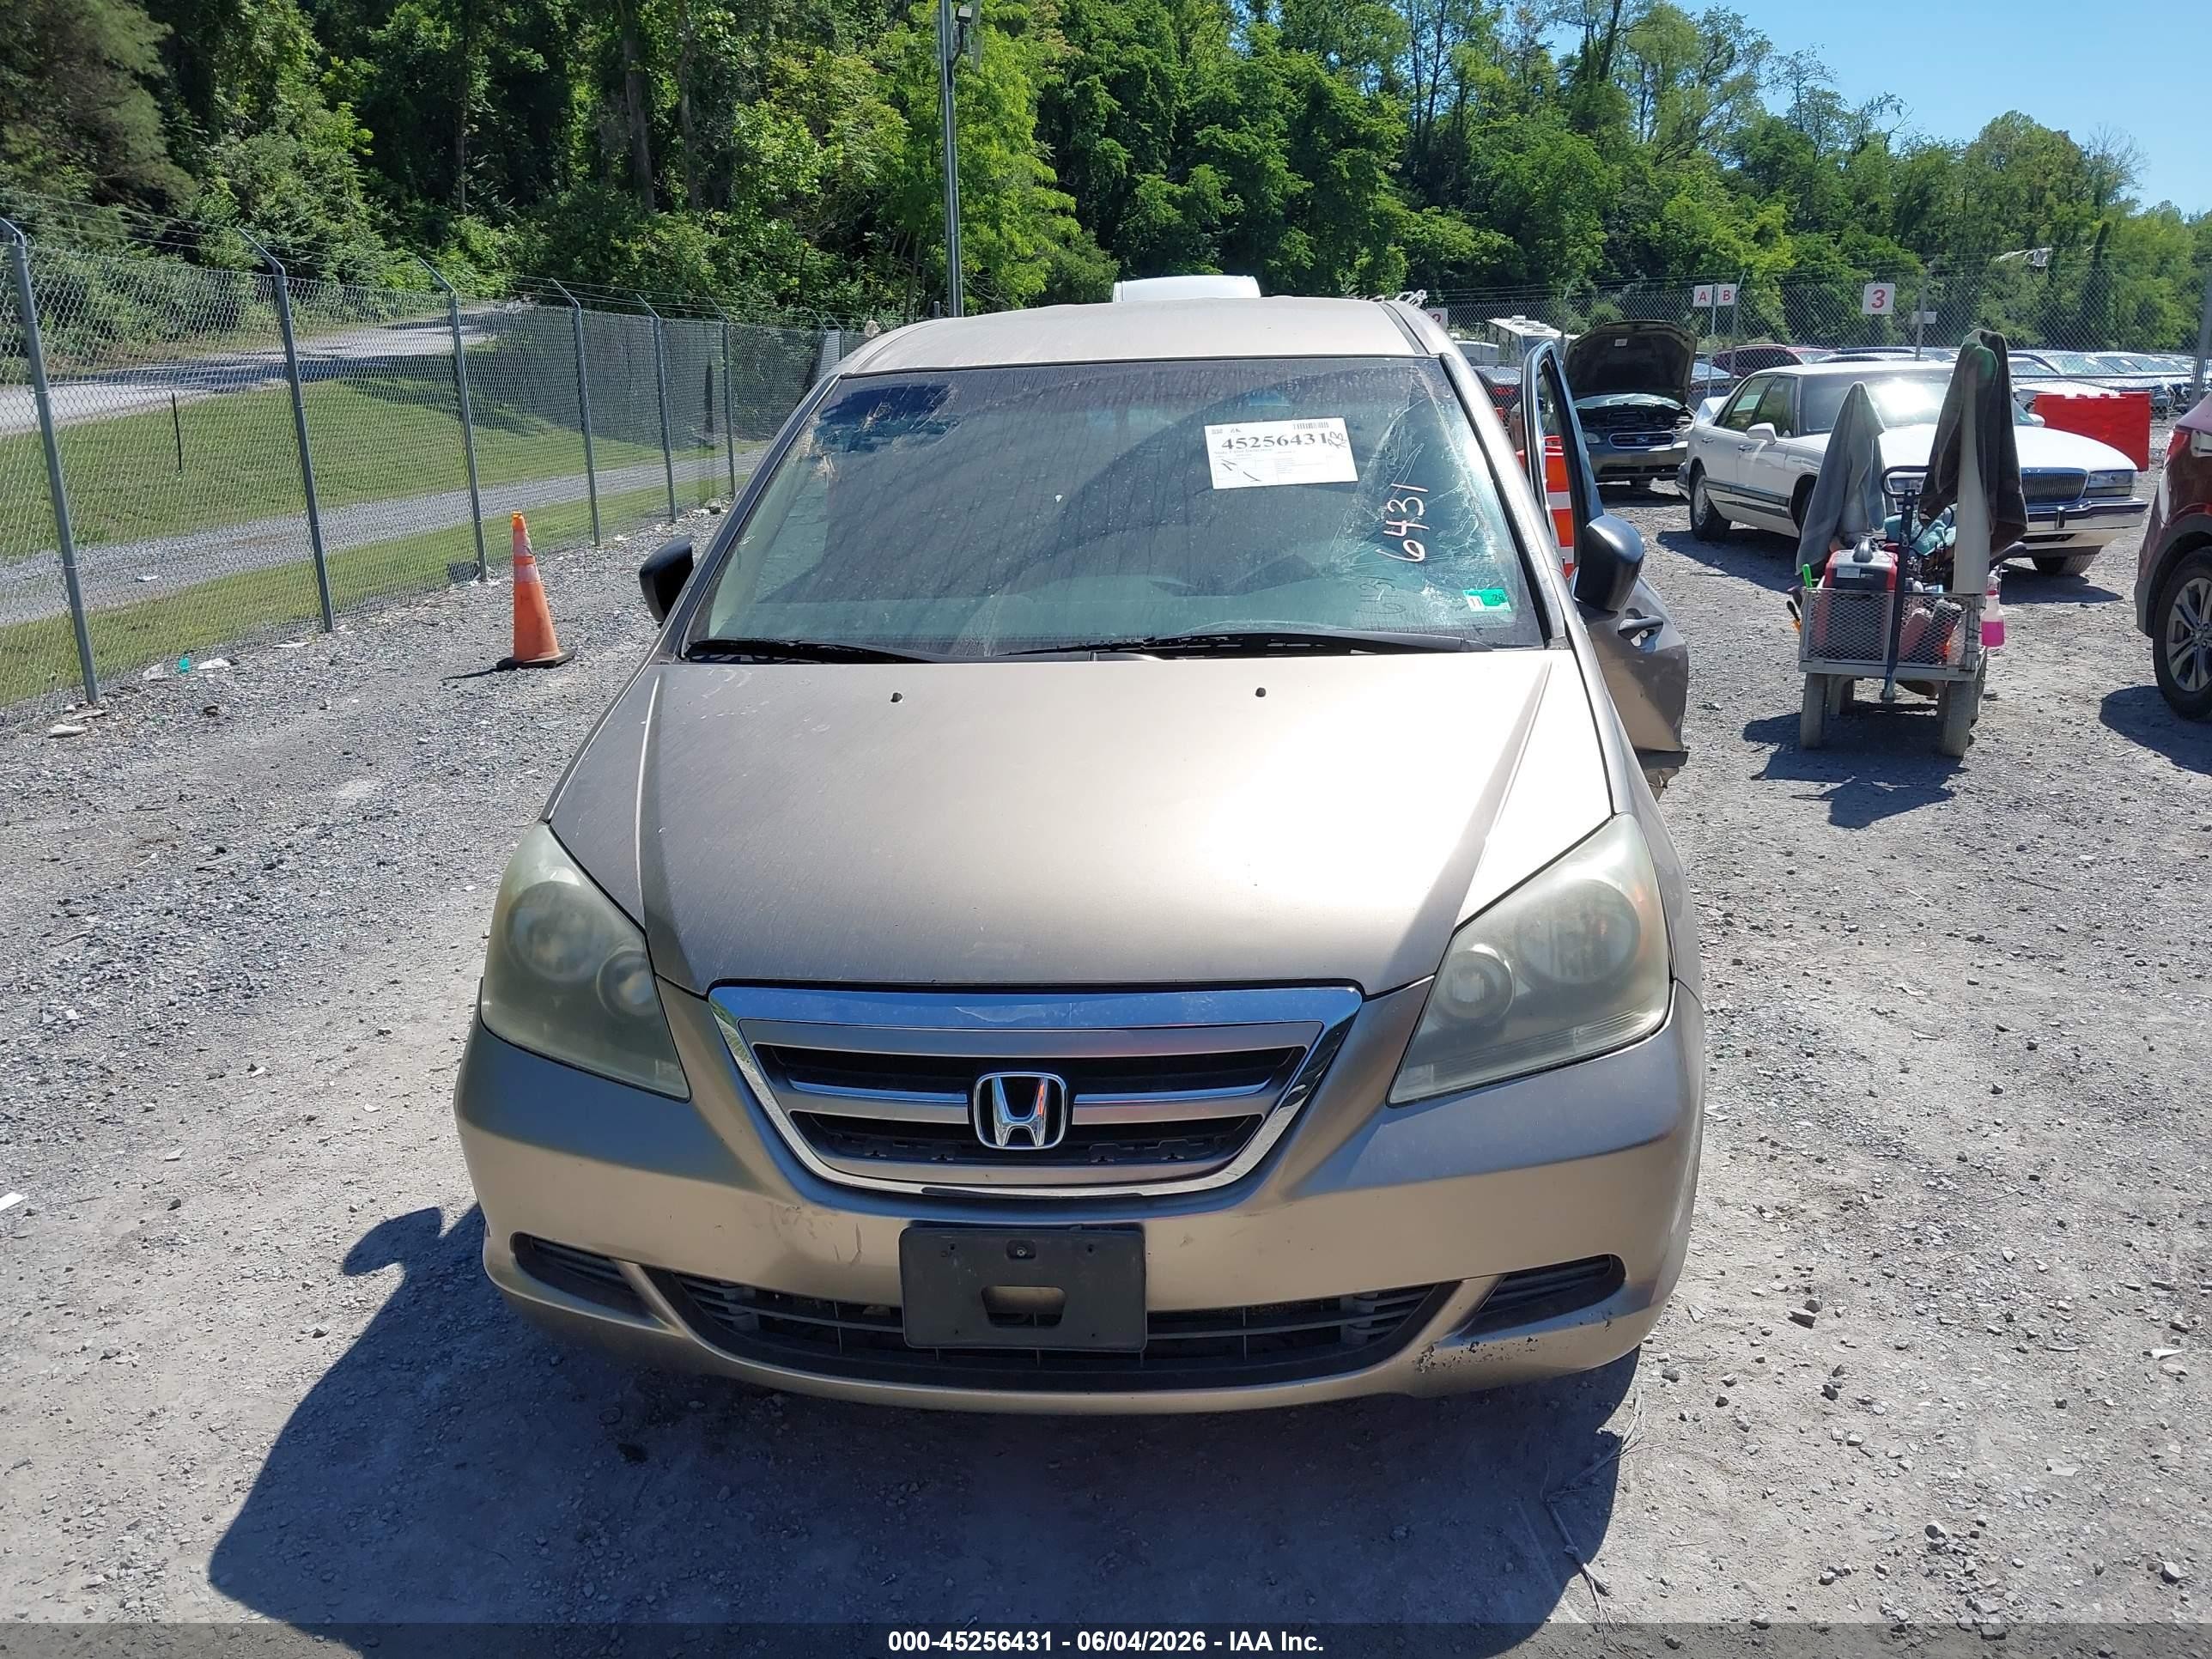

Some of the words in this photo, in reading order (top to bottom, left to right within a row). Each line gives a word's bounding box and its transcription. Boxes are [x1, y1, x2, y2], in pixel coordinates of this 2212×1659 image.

[1698, 291, 1707, 302] A
[1723, 289, 1731, 301] B
[1871, 289, 1887, 309] 3
[1221, 432, 1328, 450] 45256431
[1375, 483, 1430, 562] 6431
